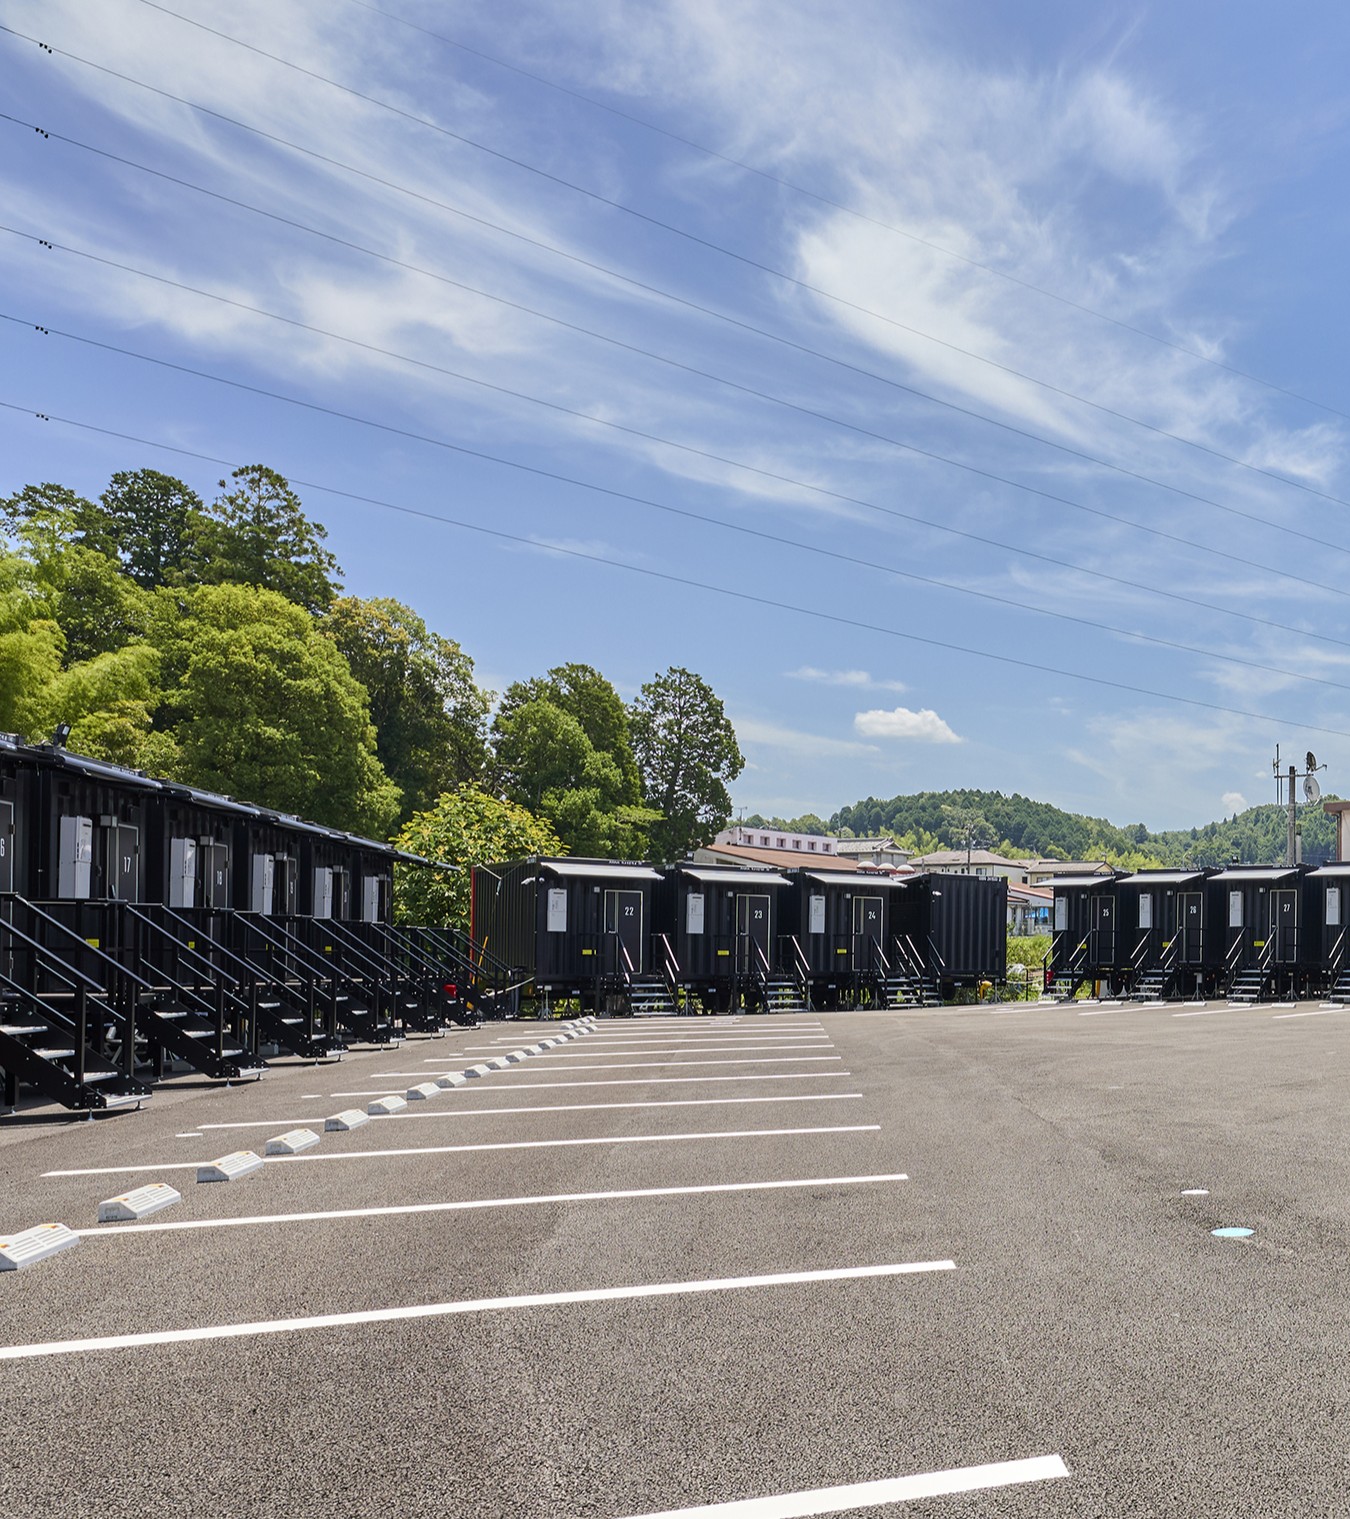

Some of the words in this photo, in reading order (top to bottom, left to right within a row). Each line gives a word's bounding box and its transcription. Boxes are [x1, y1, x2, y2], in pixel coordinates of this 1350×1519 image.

[123, 856, 131, 873] 17
[624, 906, 634, 917] 22
[1102, 908, 1110, 917] 25
[1283, 903, 1291, 913] 27
[754, 910, 763, 920] 23
[868, 910, 876, 920] 24
